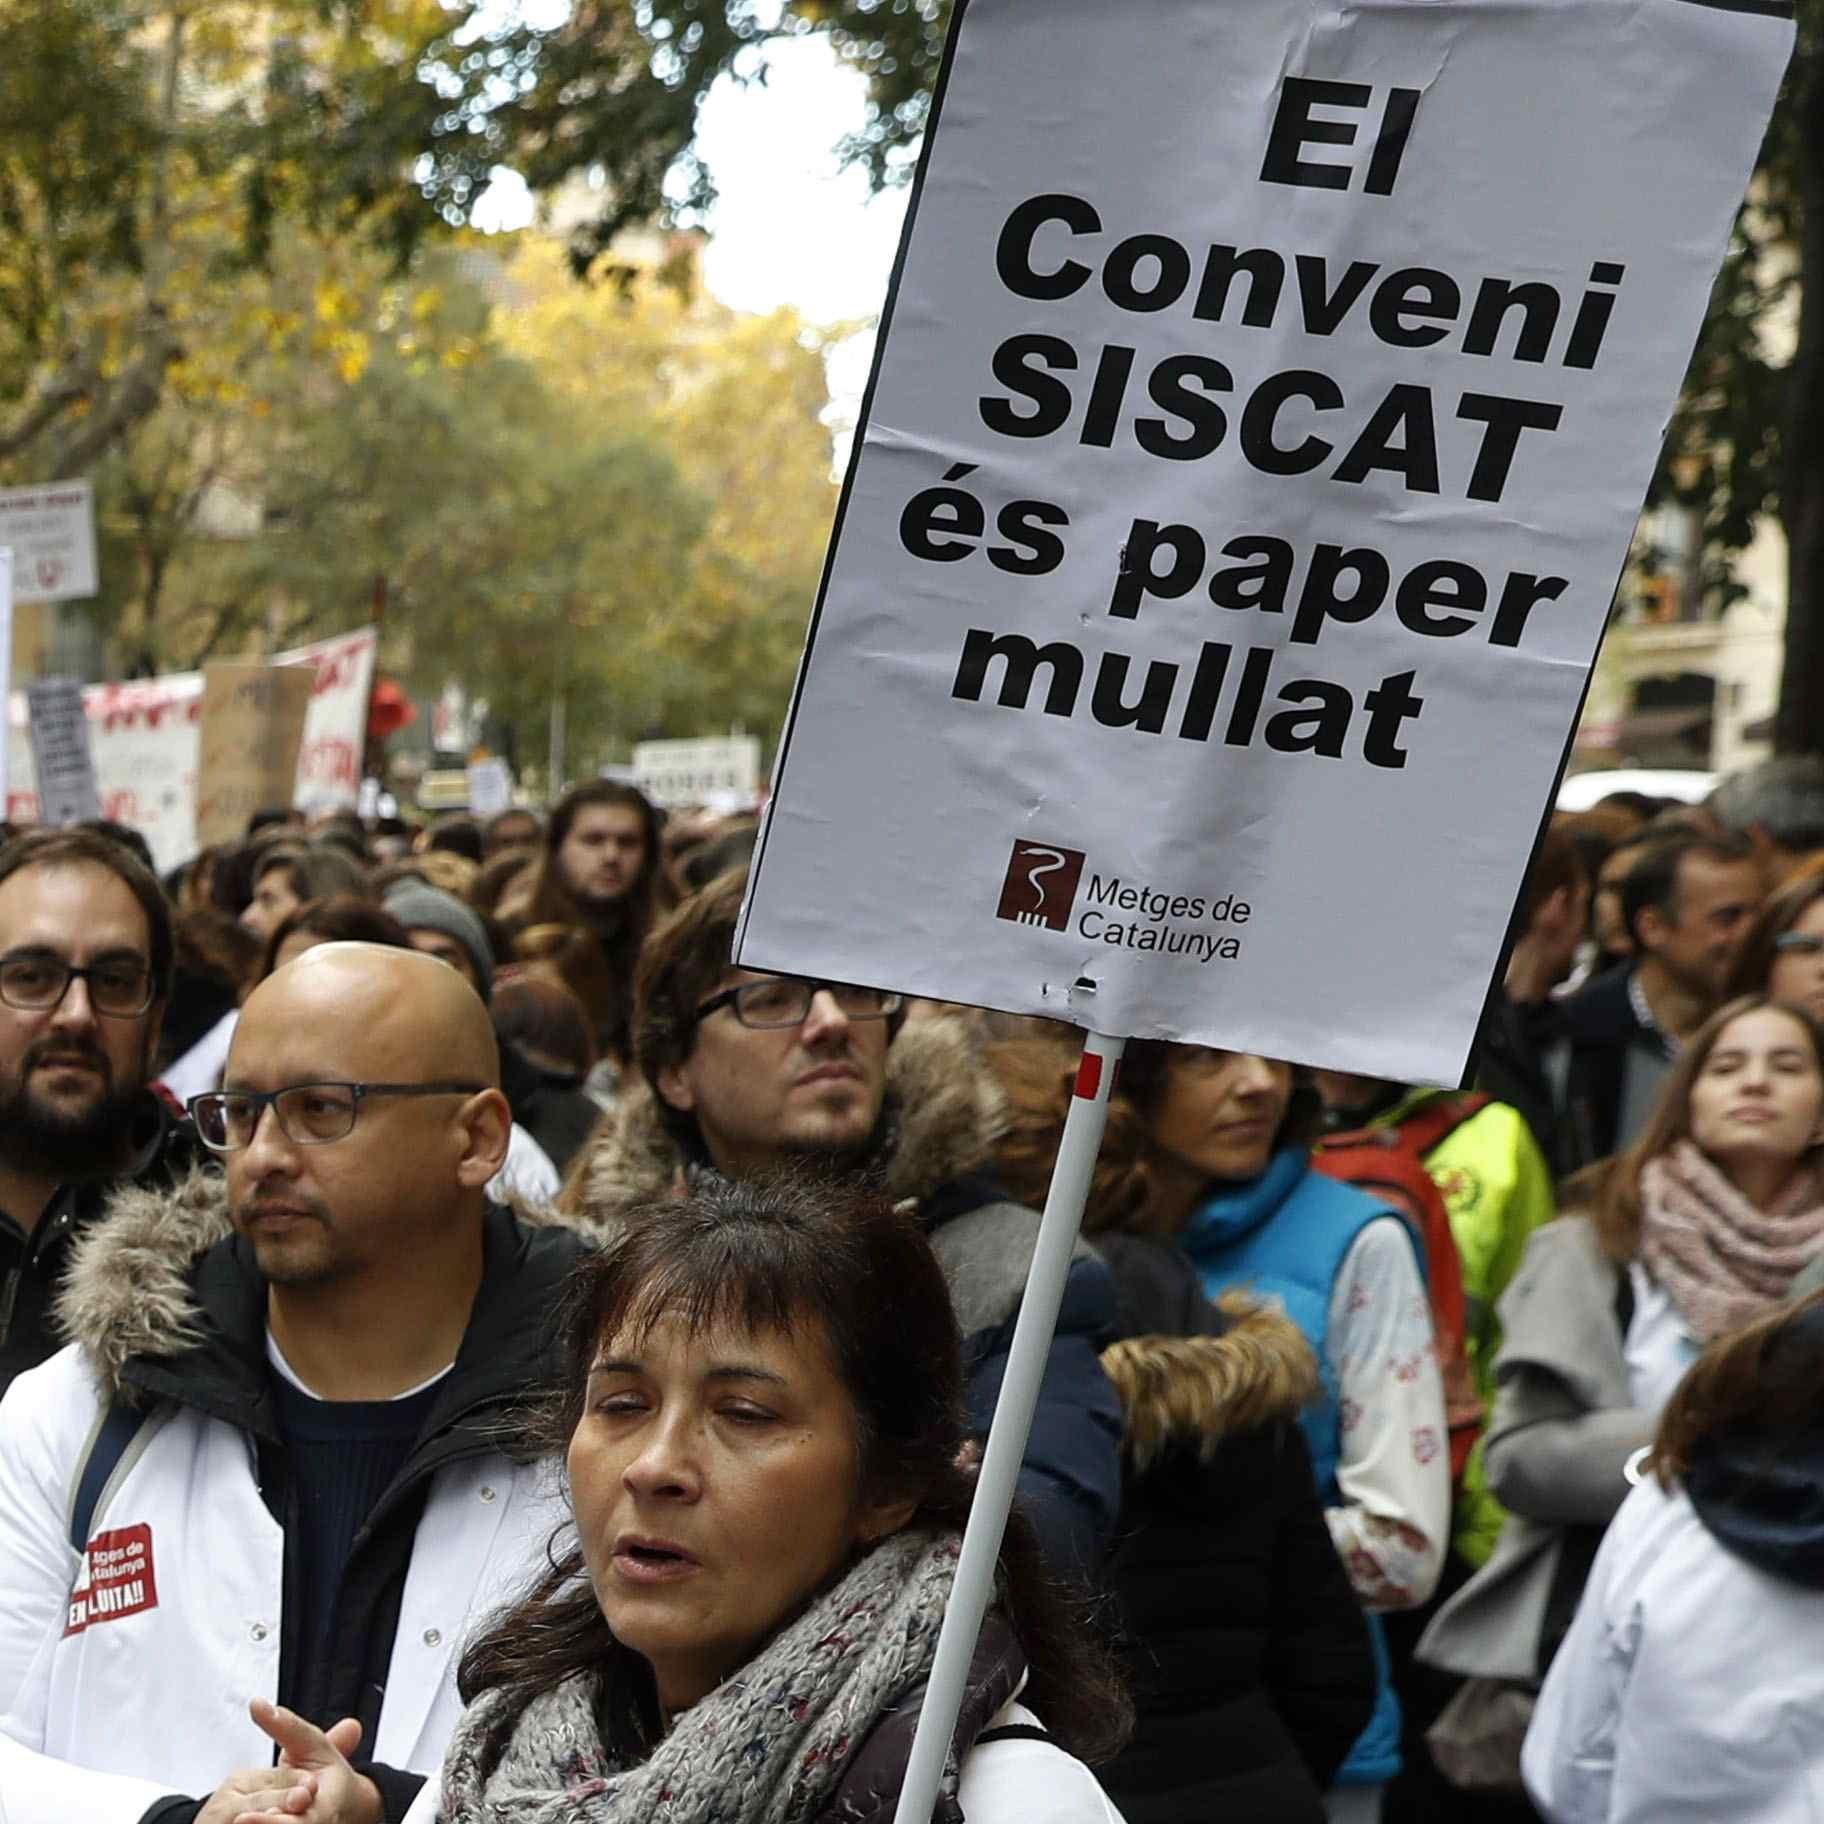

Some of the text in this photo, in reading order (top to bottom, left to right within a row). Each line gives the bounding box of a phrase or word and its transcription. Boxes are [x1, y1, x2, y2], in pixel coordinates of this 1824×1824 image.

[1260, 76, 1421, 195] El
[995, 194, 1625, 369] Conveni
[979, 334, 1563, 503] SISCAT
[899, 464, 1570, 649] és paper
[952, 627, 1423, 767] mullat
[1079, 911, 1240, 962] Catalunya
[1087, 875, 1250, 923] Metges de
[69, 1580, 144, 1627] EN LUITA!!
[126, 1541, 144, 1556] de
